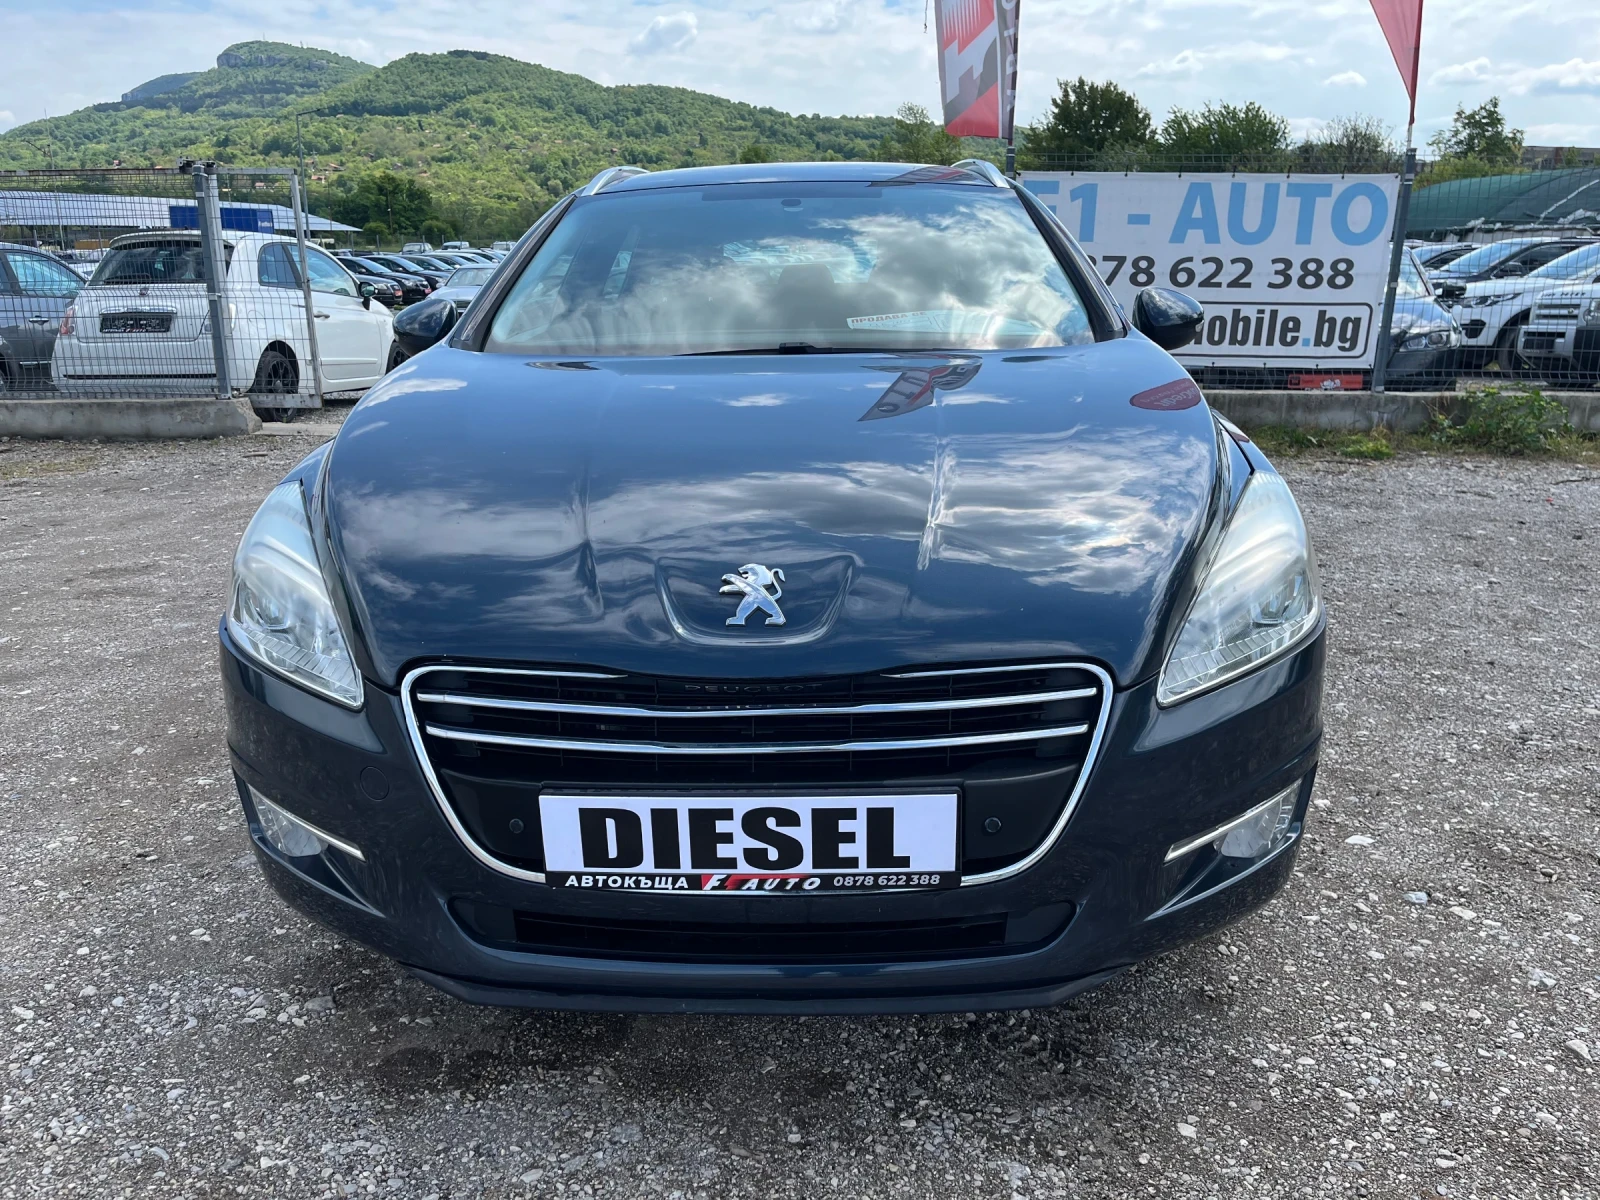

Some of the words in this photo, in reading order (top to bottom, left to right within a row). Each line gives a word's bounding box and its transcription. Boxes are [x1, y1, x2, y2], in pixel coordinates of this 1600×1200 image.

[1169, 182, 1389, 247] AUTO
[1087, 254, 1155, 287] 78
[1169, 256, 1254, 288] 622
[1267, 257, 1355, 290] 388
[1194, 308, 1362, 351] obile.bg
[684, 683, 823, 693] PEUGEOT
[578, 807, 911, 870] DIESEL
[565, 875, 689, 889] АВТОКЪЩА
[742, 878, 821, 890] AUTO
[833, 875, 874, 887] 0878
[878, 875, 907, 886] 622
[909, 874, 941, 885] 388
